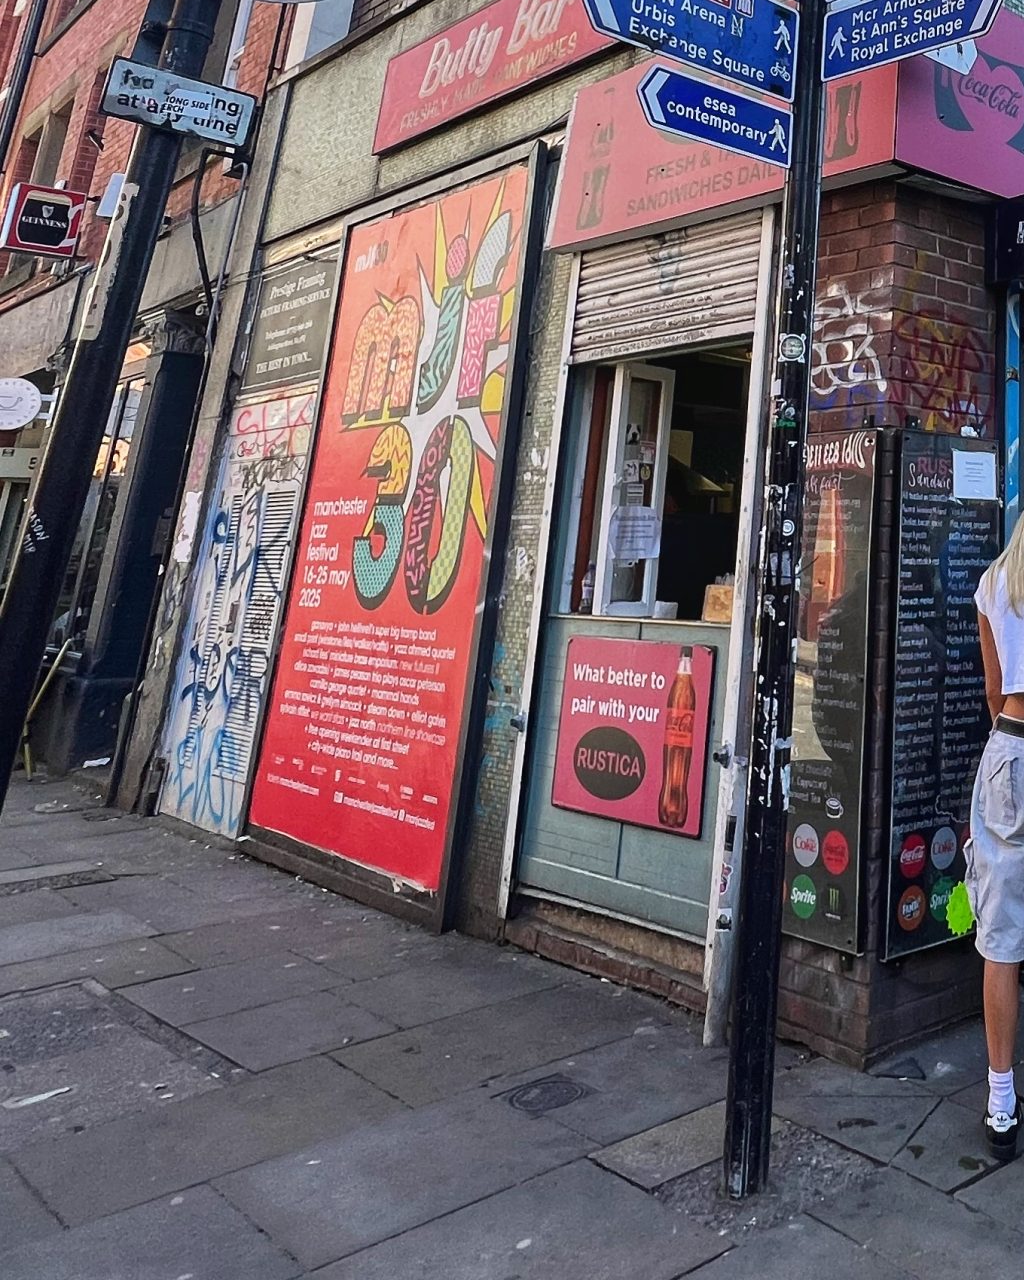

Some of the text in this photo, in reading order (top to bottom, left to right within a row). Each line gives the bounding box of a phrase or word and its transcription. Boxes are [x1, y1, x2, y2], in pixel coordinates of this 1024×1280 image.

[851, 28, 867, 44] St
[871, 15, 908, 37] Ann's
[852, 8, 878, 26] Mcr
[629, 16, 765, 82] Exchange Square
[851, 18, 963, 63] Royal Exchange
[418, 21, 503, 99] Butty
[117, 93, 139, 109] at
[190, 100, 212, 111] SIDE
[703, 96, 737, 117] esea
[666, 101, 768, 146] contemporary
[645, 153, 697, 185] FRESH
[626, 161, 784, 217] SANDWICHES DAIL
[21, 215, 68, 229] GUINNESS
[269, 271, 327, 301] Prestige Framing
[313, 497, 368, 517] manchester
[351, 414, 474, 614] 30
[309, 521, 329, 543] jazz
[306, 543, 339, 562] festival
[303, 566, 351, 589] 16-25 may
[299, 588, 322, 609] 2025
[573, 663, 666, 690] What better to
[571, 696, 660, 723] pair with your
[576, 747, 641, 779] RUSTICA
[791, 885, 816, 905] Sprite
